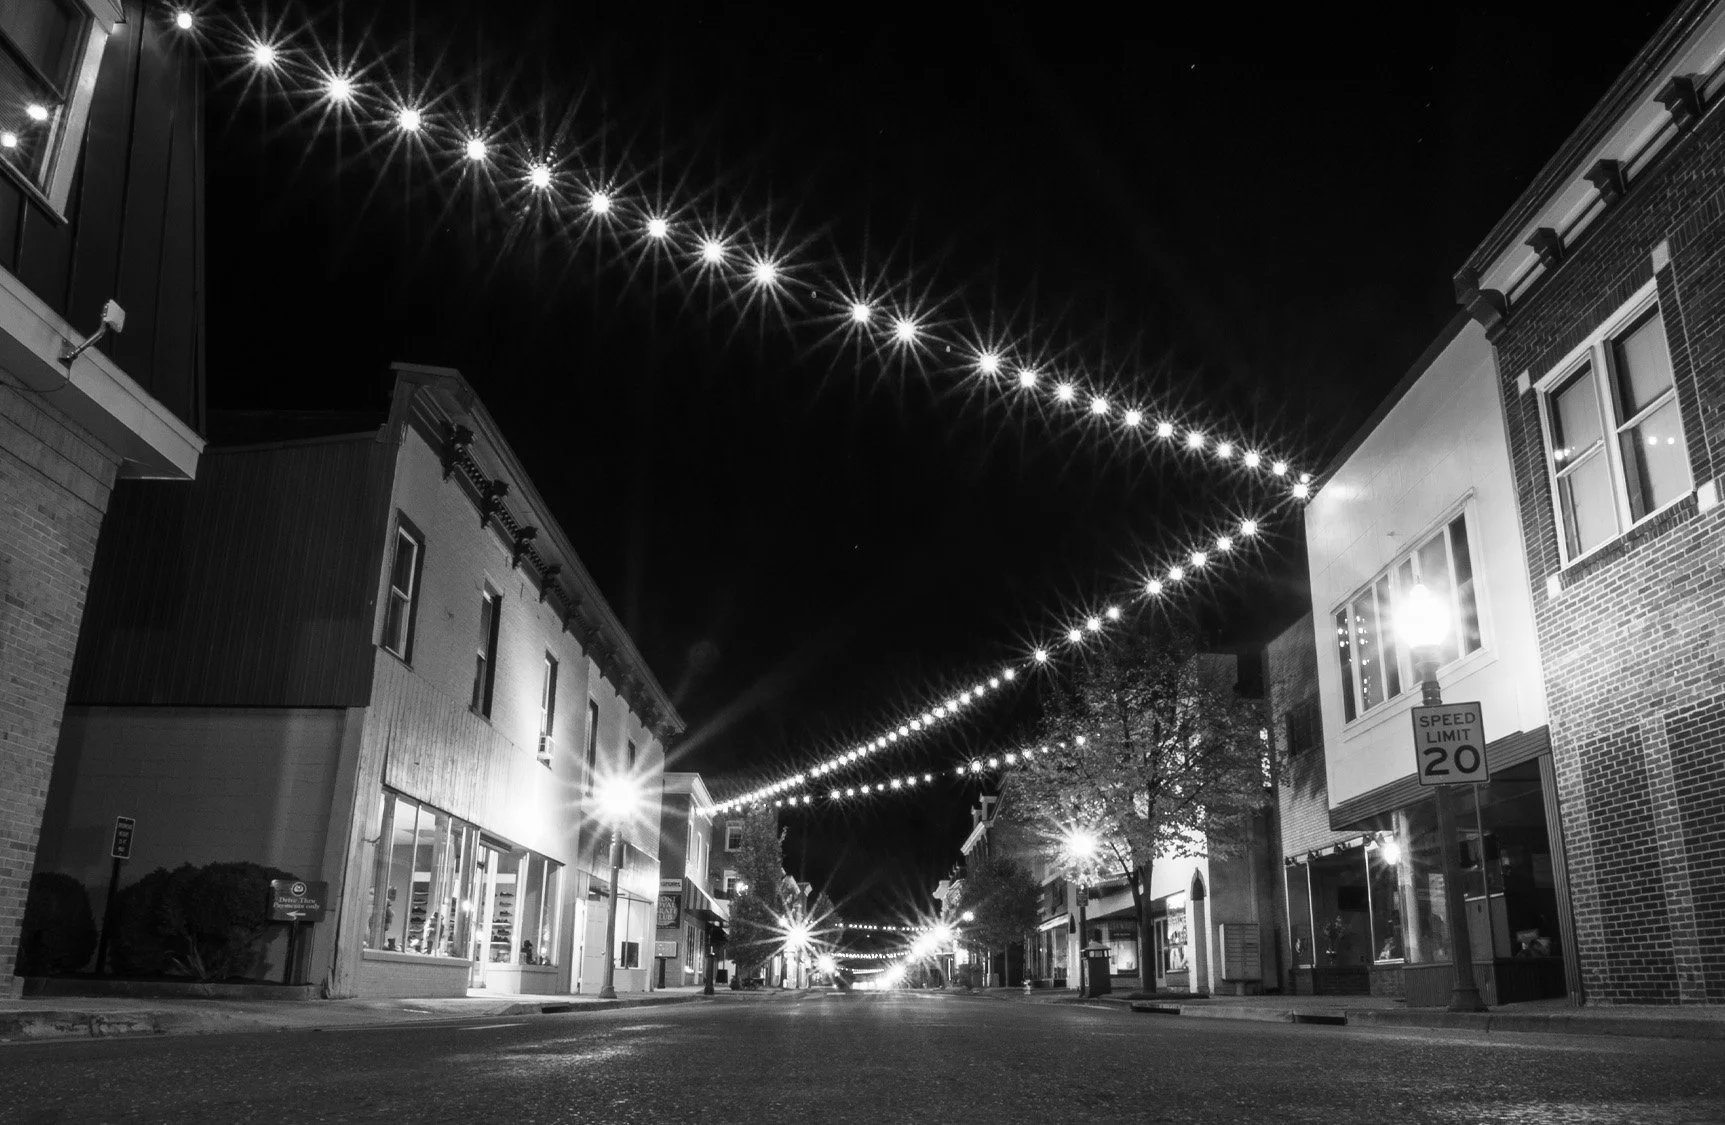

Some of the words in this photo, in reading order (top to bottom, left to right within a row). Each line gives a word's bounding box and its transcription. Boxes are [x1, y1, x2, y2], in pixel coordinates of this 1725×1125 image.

[1419, 712, 1476, 728] SPEED
[1426, 728, 1472, 744] LIMIT
[1423, 744, 1481, 777] 20
